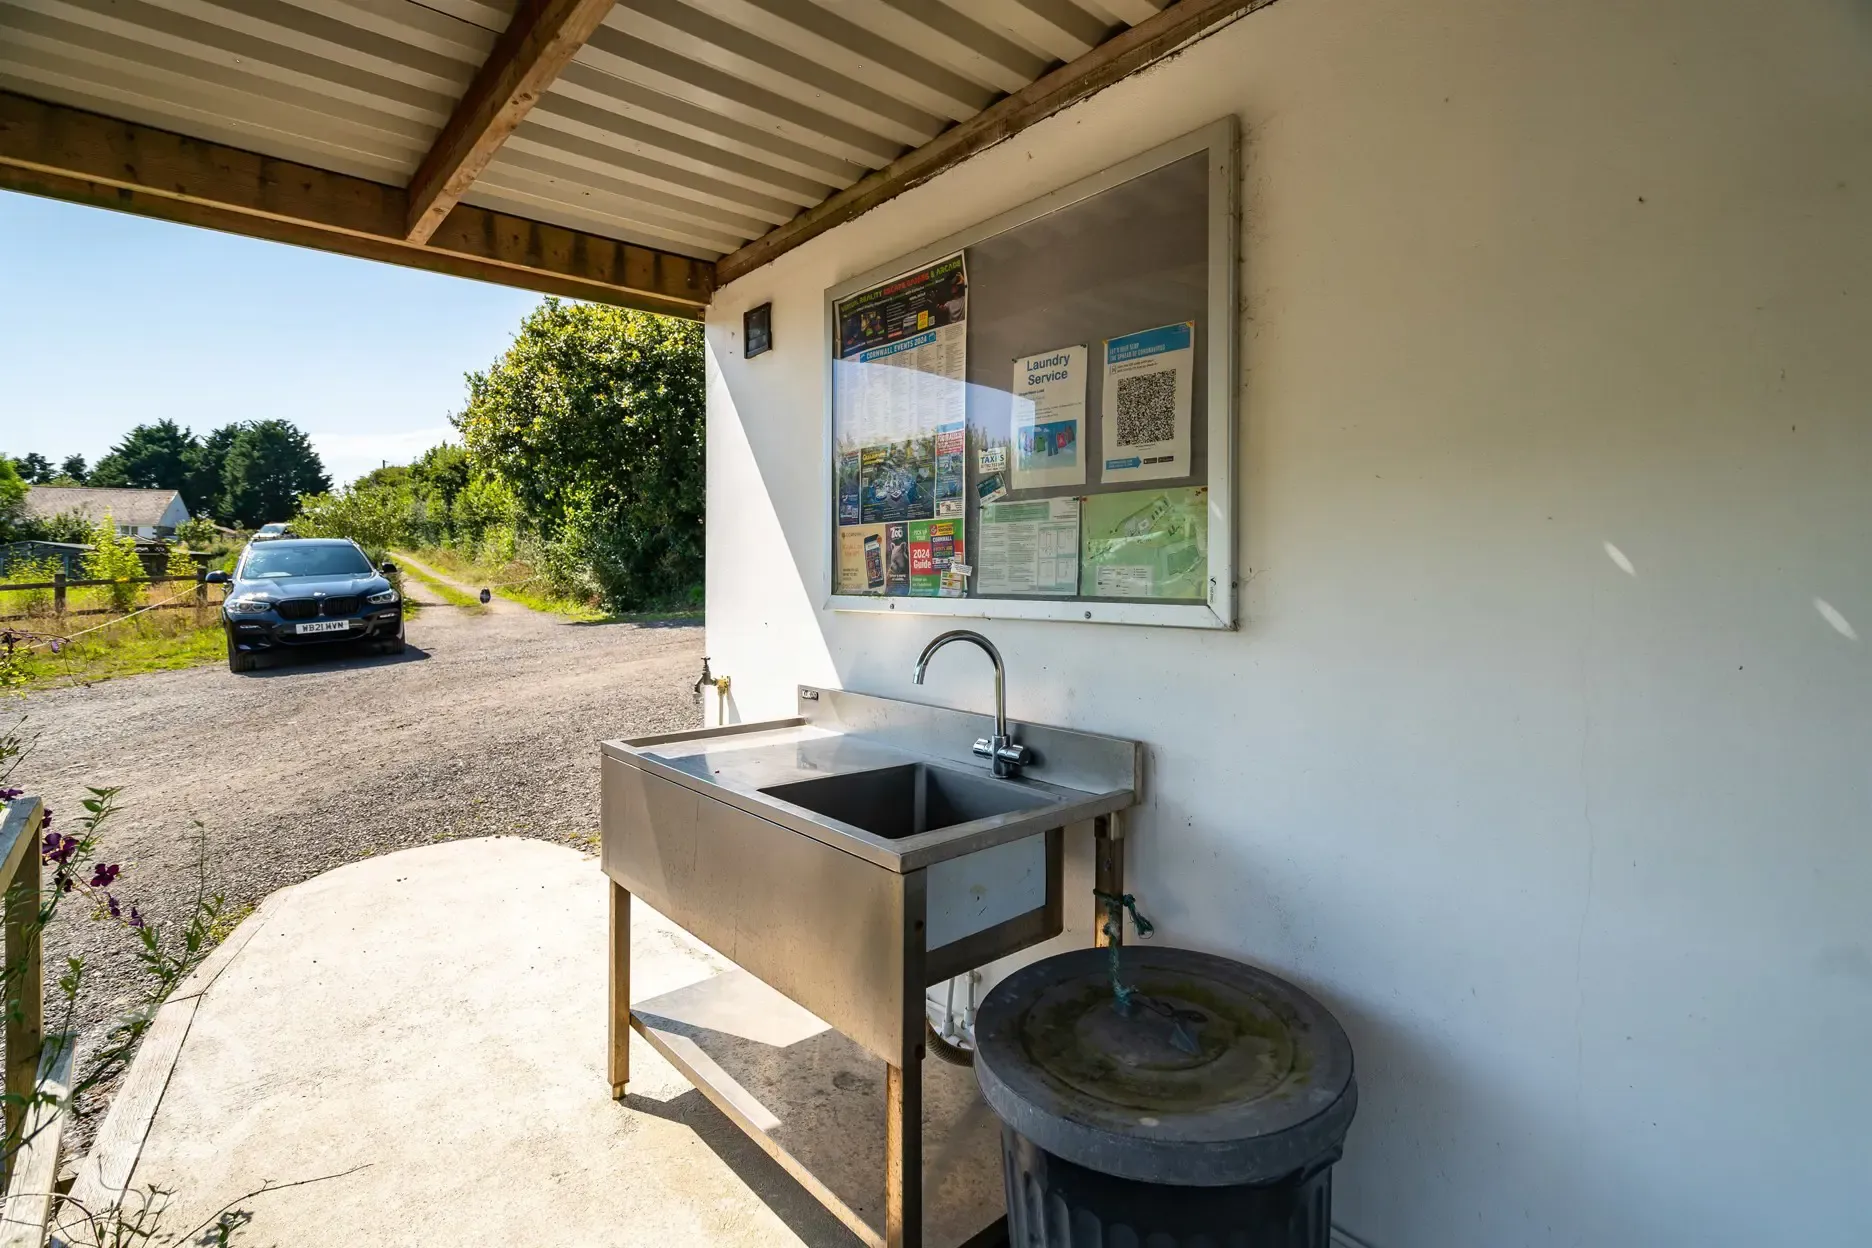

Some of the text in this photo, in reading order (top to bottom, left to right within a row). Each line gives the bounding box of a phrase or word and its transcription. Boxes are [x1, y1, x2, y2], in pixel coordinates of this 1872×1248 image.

[936, 259, 962, 276] ARCADE
[866, 347, 894, 360] CORNWALL
[894, 341, 914, 353] EVENTS
[914, 335, 928, 347] 2024
[1026, 353, 1070, 372] Laundry
[1027, 370, 1068, 386] Service
[913, 548, 930, 559] 2024
[913, 559, 932, 569] Guide
[302, 623, 324, 632] WB21
